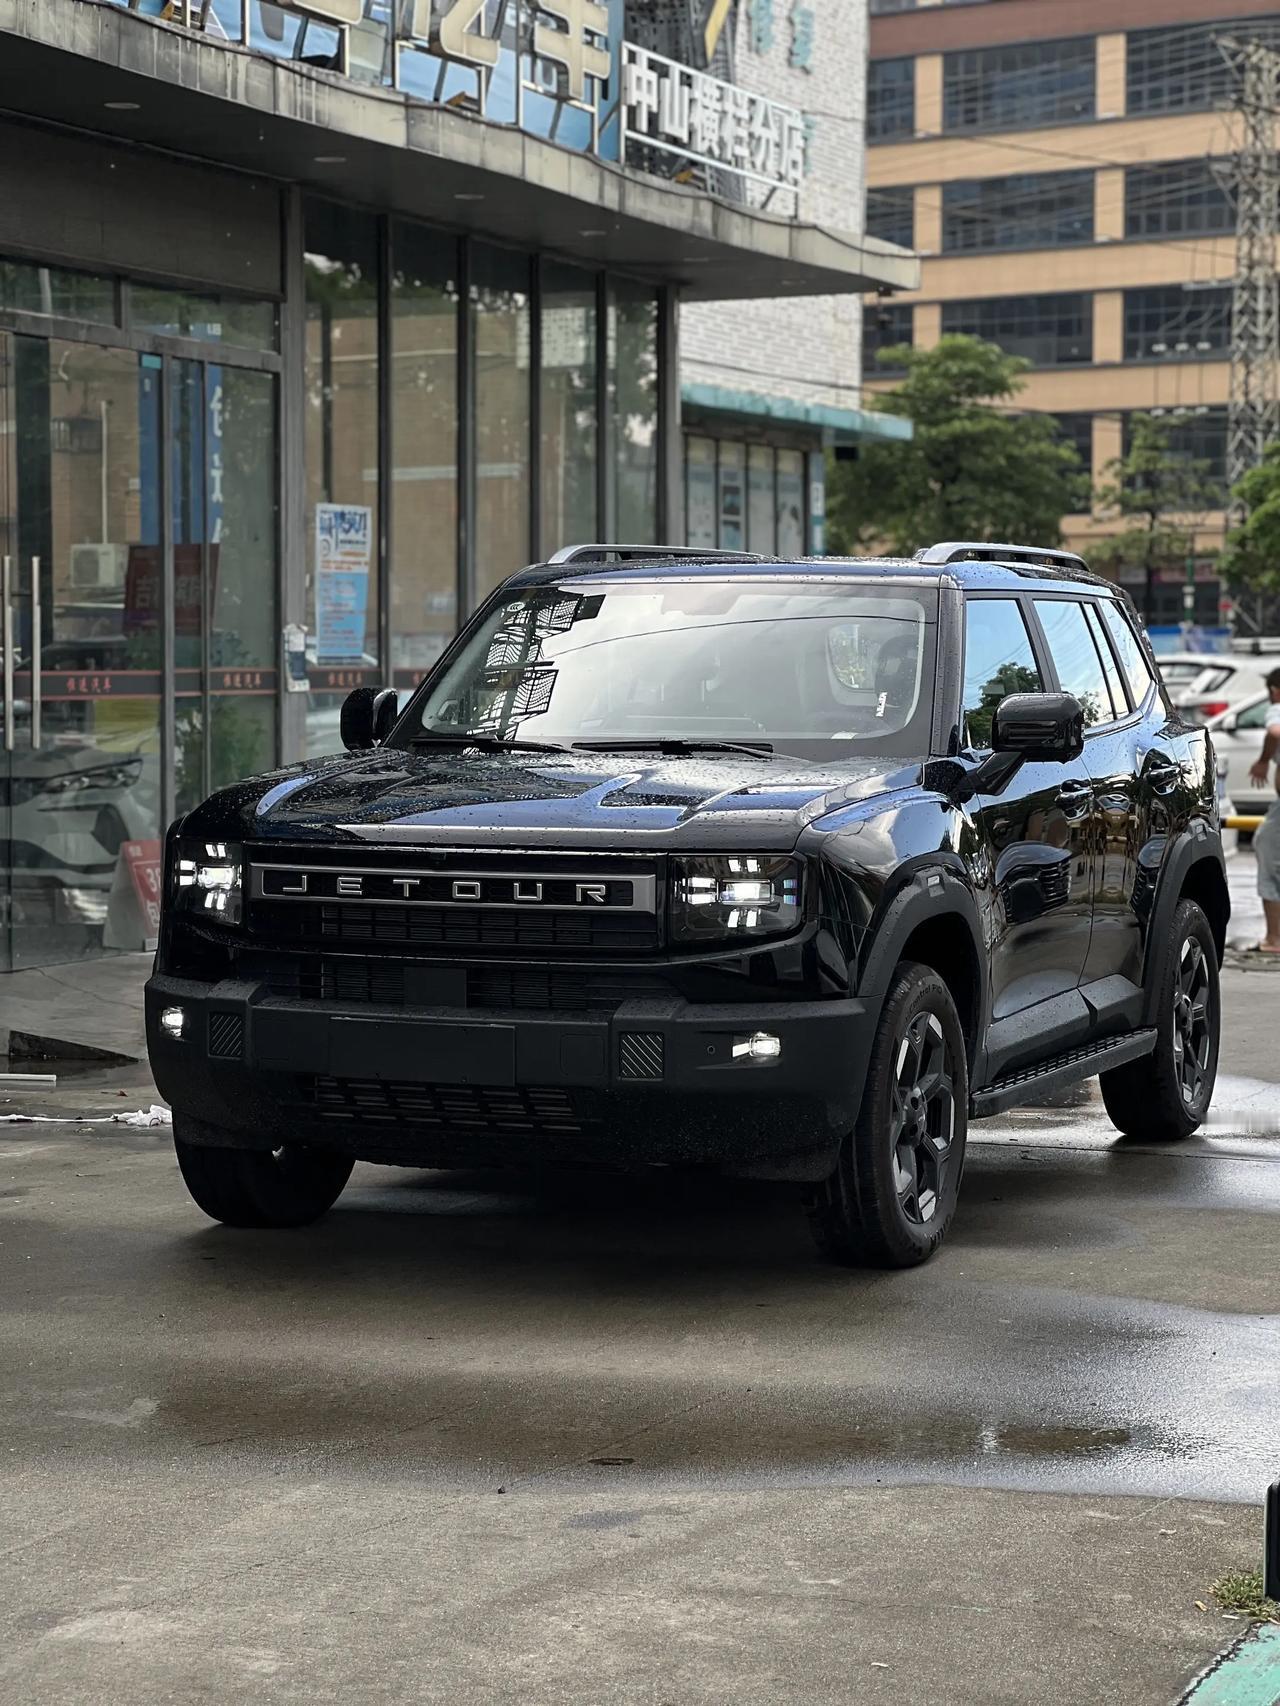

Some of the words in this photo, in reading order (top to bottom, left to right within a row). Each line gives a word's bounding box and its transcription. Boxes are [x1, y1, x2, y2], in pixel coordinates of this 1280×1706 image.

[623, 50, 806, 183] 中山横栏分店
[282, 875, 606, 903] JETOUR
